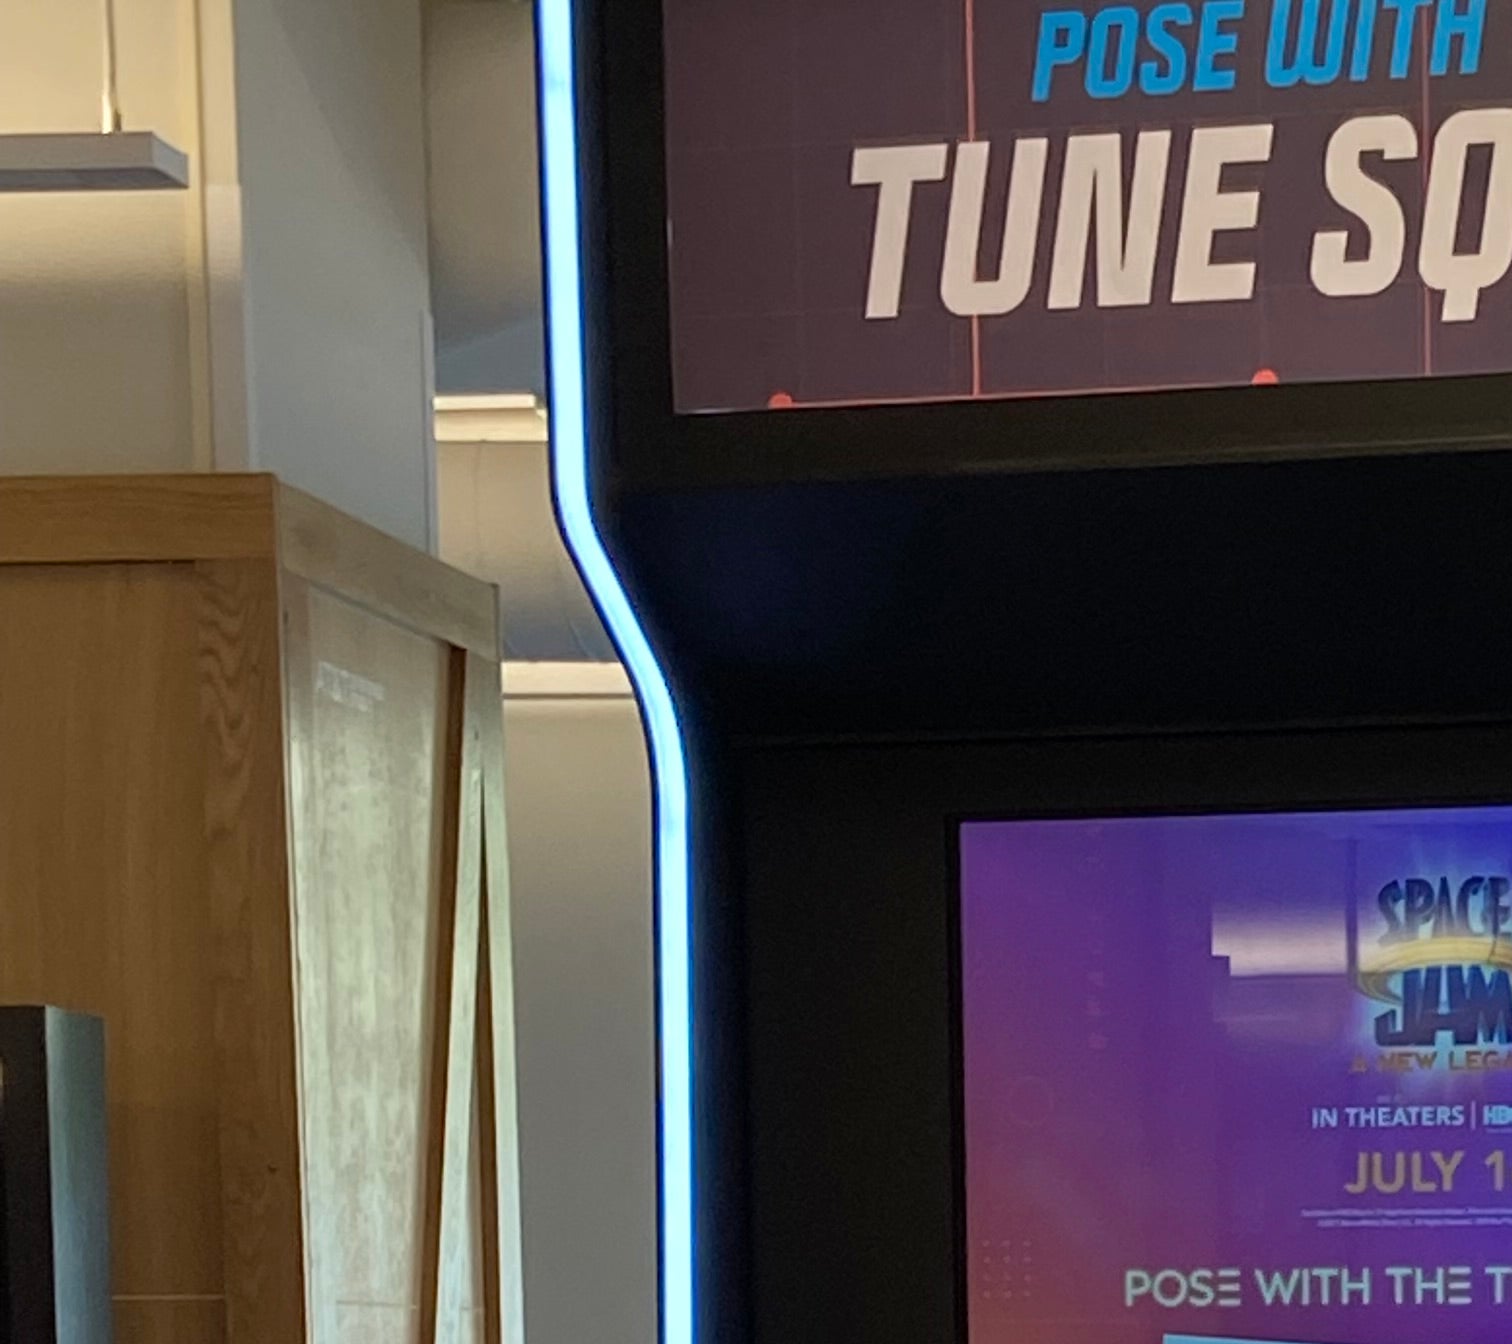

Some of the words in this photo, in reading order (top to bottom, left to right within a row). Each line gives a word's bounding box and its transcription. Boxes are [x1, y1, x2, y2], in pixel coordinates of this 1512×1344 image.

[1031, 1, 1244, 102] POSE
[1264, 0, 1490, 88] WITH
[848, 122, 1276, 320] TUNE
[1312, 1107, 1338, 1129] IN
[1345, 1104, 1465, 1128] THEATERS
[1343, 1150, 1465, 1195] JULY
[1124, 1268, 1243, 1308] POSE
[1252, 1266, 1370, 1306] WITH
[1385, 1266, 1473, 1306] THE
